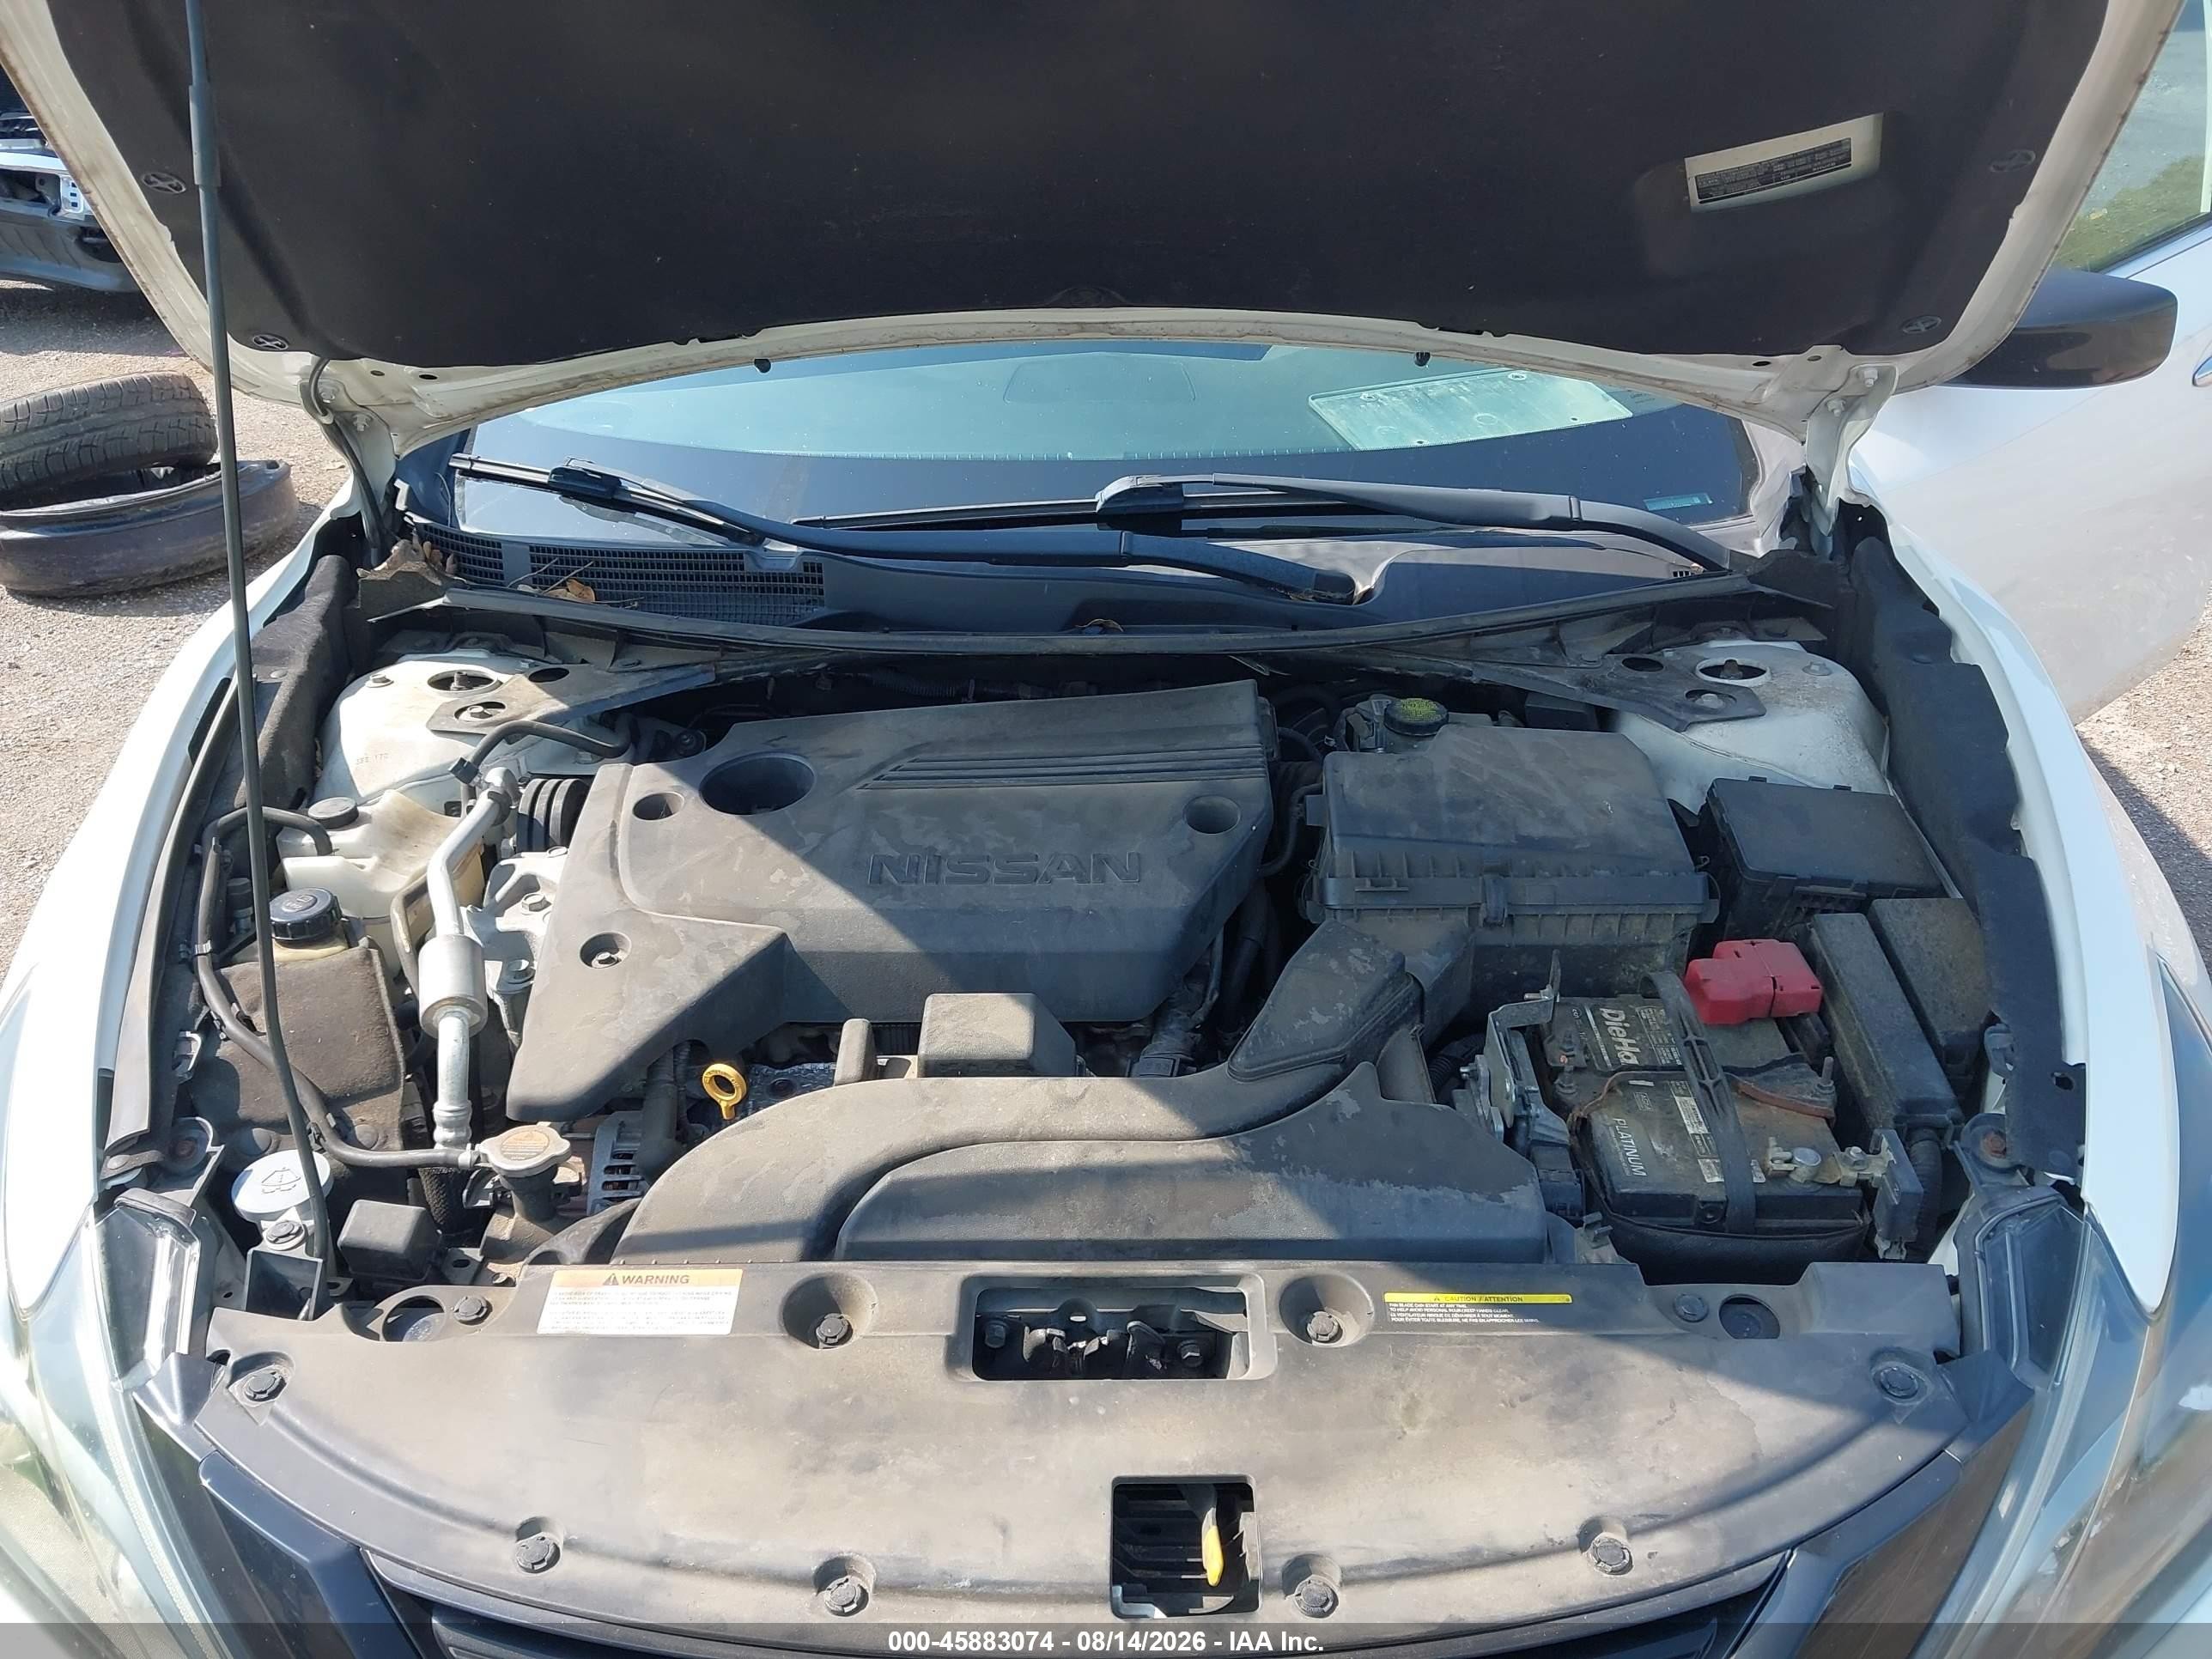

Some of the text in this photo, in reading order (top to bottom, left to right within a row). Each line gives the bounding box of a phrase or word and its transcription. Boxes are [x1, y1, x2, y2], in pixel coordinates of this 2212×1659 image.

[868, 851, 1140, 885] NISSAN
[1613, 1118, 1648, 1177] PLATINUM
[622, 1274, 690, 1285] WARNING
